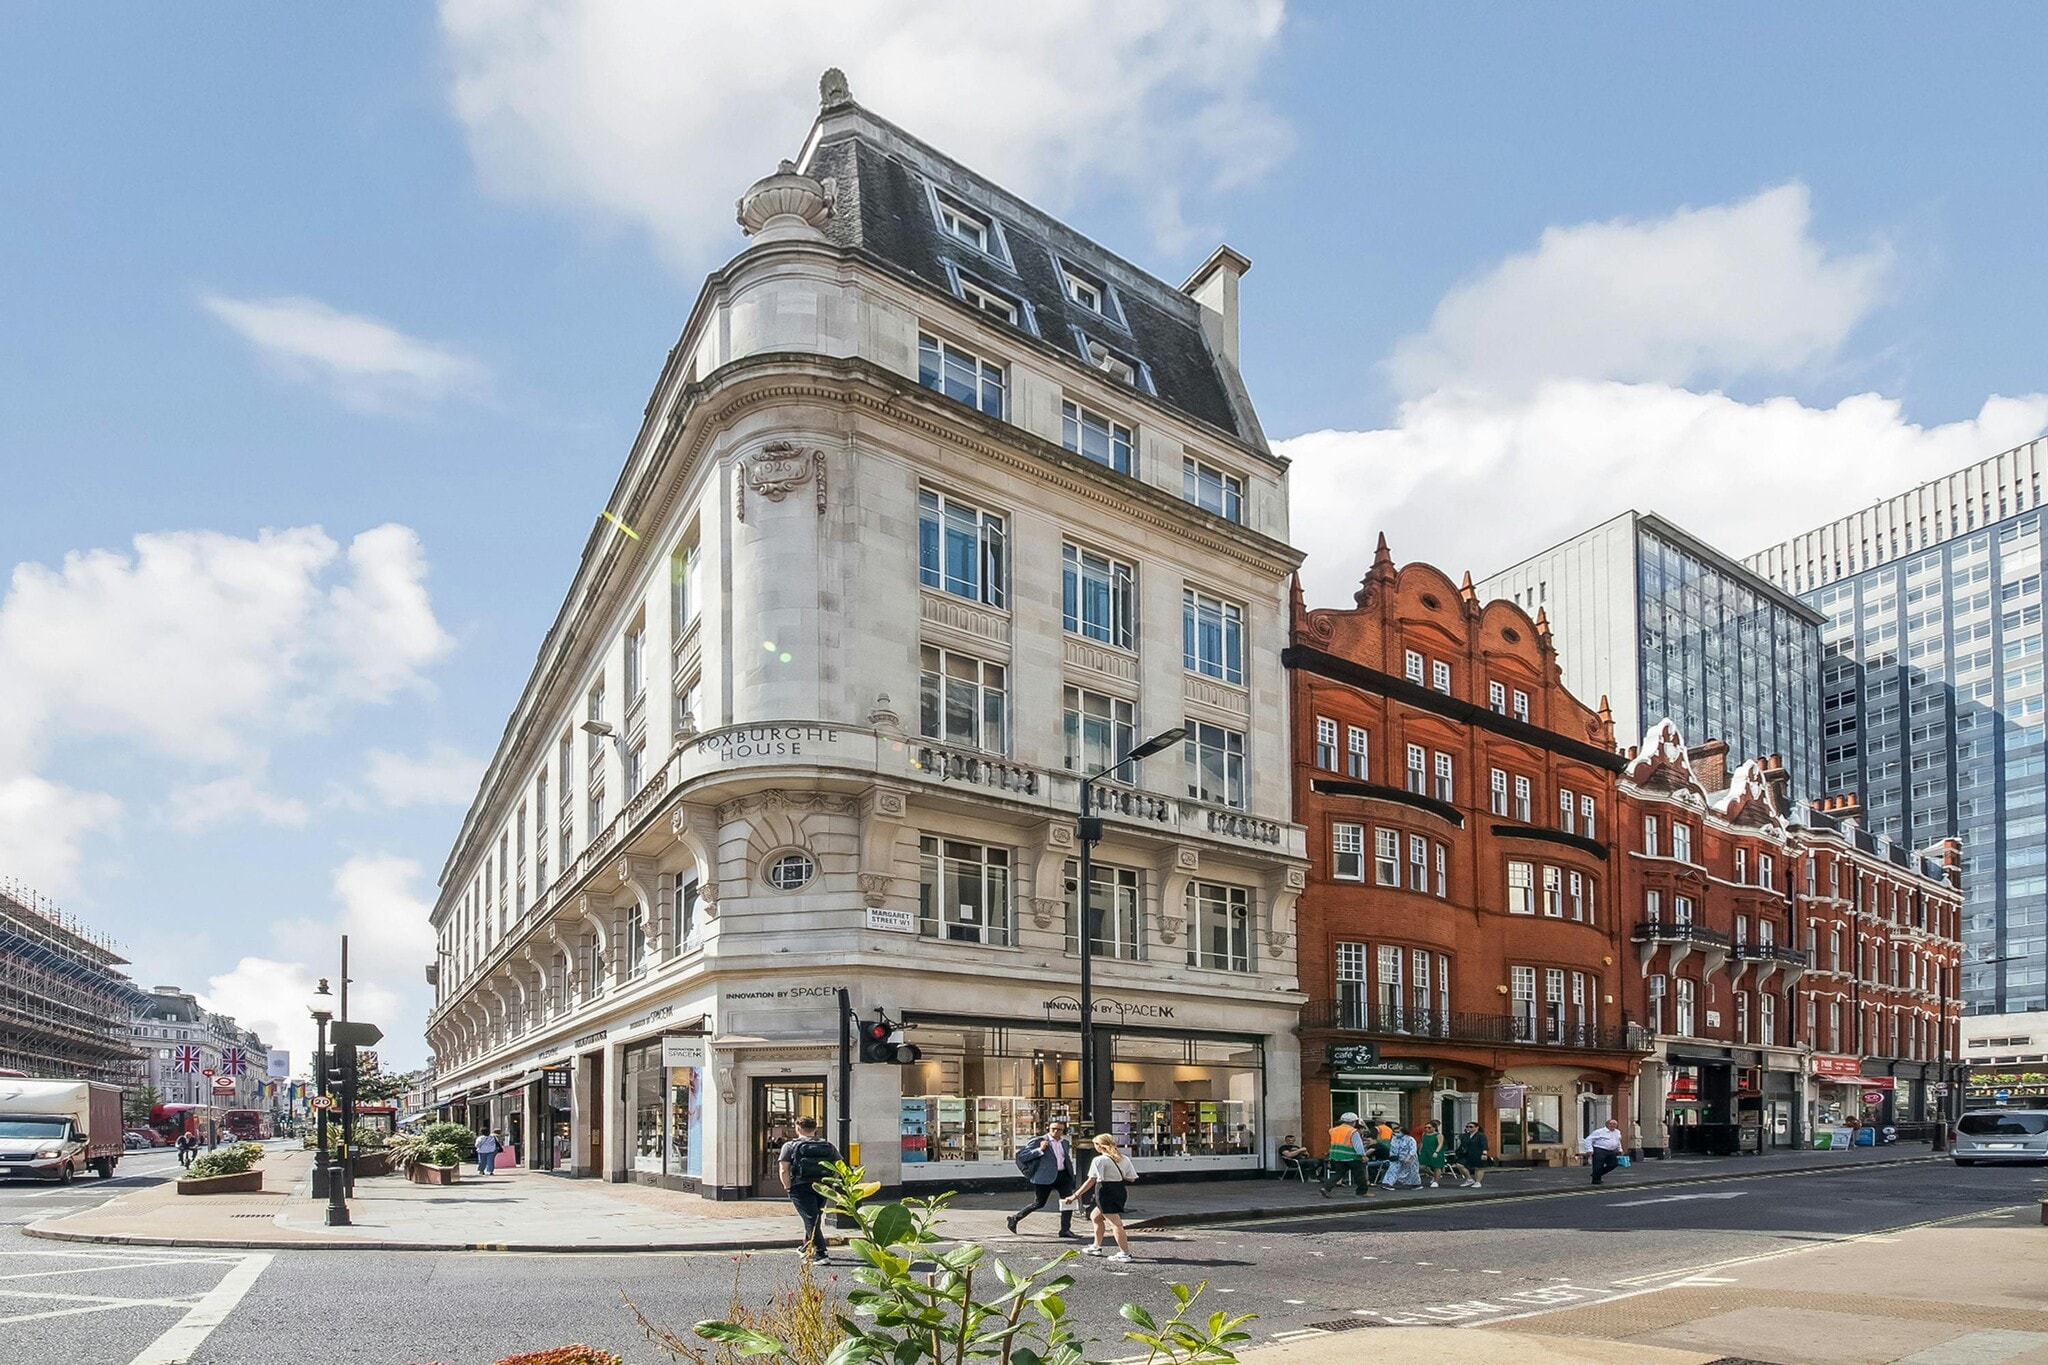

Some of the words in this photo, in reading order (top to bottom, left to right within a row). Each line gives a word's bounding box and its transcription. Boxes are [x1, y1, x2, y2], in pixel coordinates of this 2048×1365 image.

[696, 727, 837, 754] ROXBURGHE
[721, 743, 801, 761] HOUSE
[871, 910, 909, 919] MARGARET
[871, 916, 897, 924] STREET
[790, 986, 847, 998] SPACEN
[1115, 1003, 1174, 1018] SPACENK
[1974, 1087, 2048, 1097] PHENI
